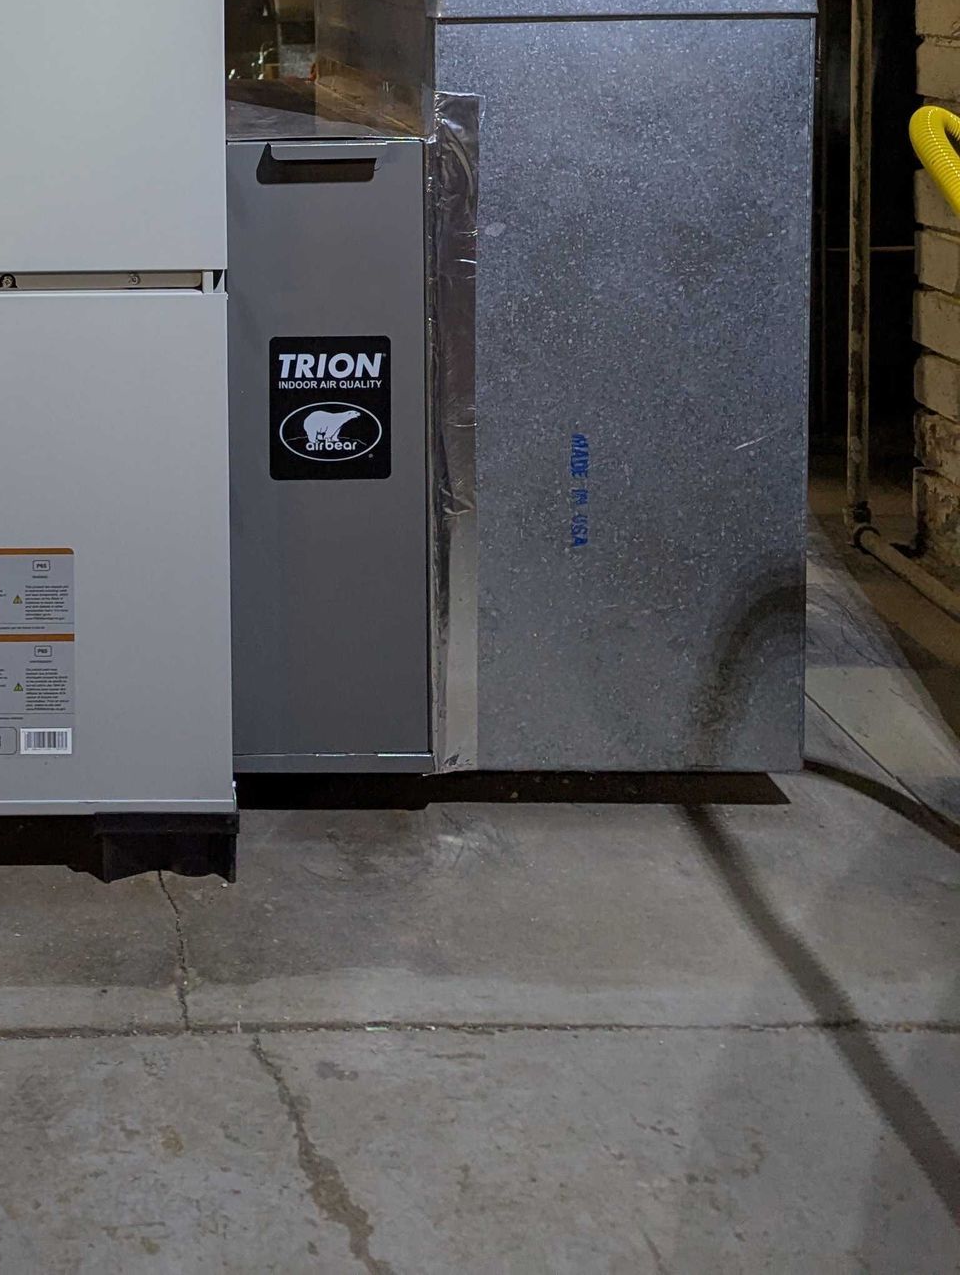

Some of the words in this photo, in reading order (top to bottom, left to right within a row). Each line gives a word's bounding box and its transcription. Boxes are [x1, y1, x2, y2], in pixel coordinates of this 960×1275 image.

[278, 352, 382, 379] TRION
[278, 380, 318, 389] INDOOR
[319, 380, 337, 389] AIR
[339, 380, 382, 389] QUALITY
[305, 439, 358, 451] airbear
[570, 433, 589, 479] MADE
[571, 488, 589, 505] IN
[570, 513, 589, 547] USA
